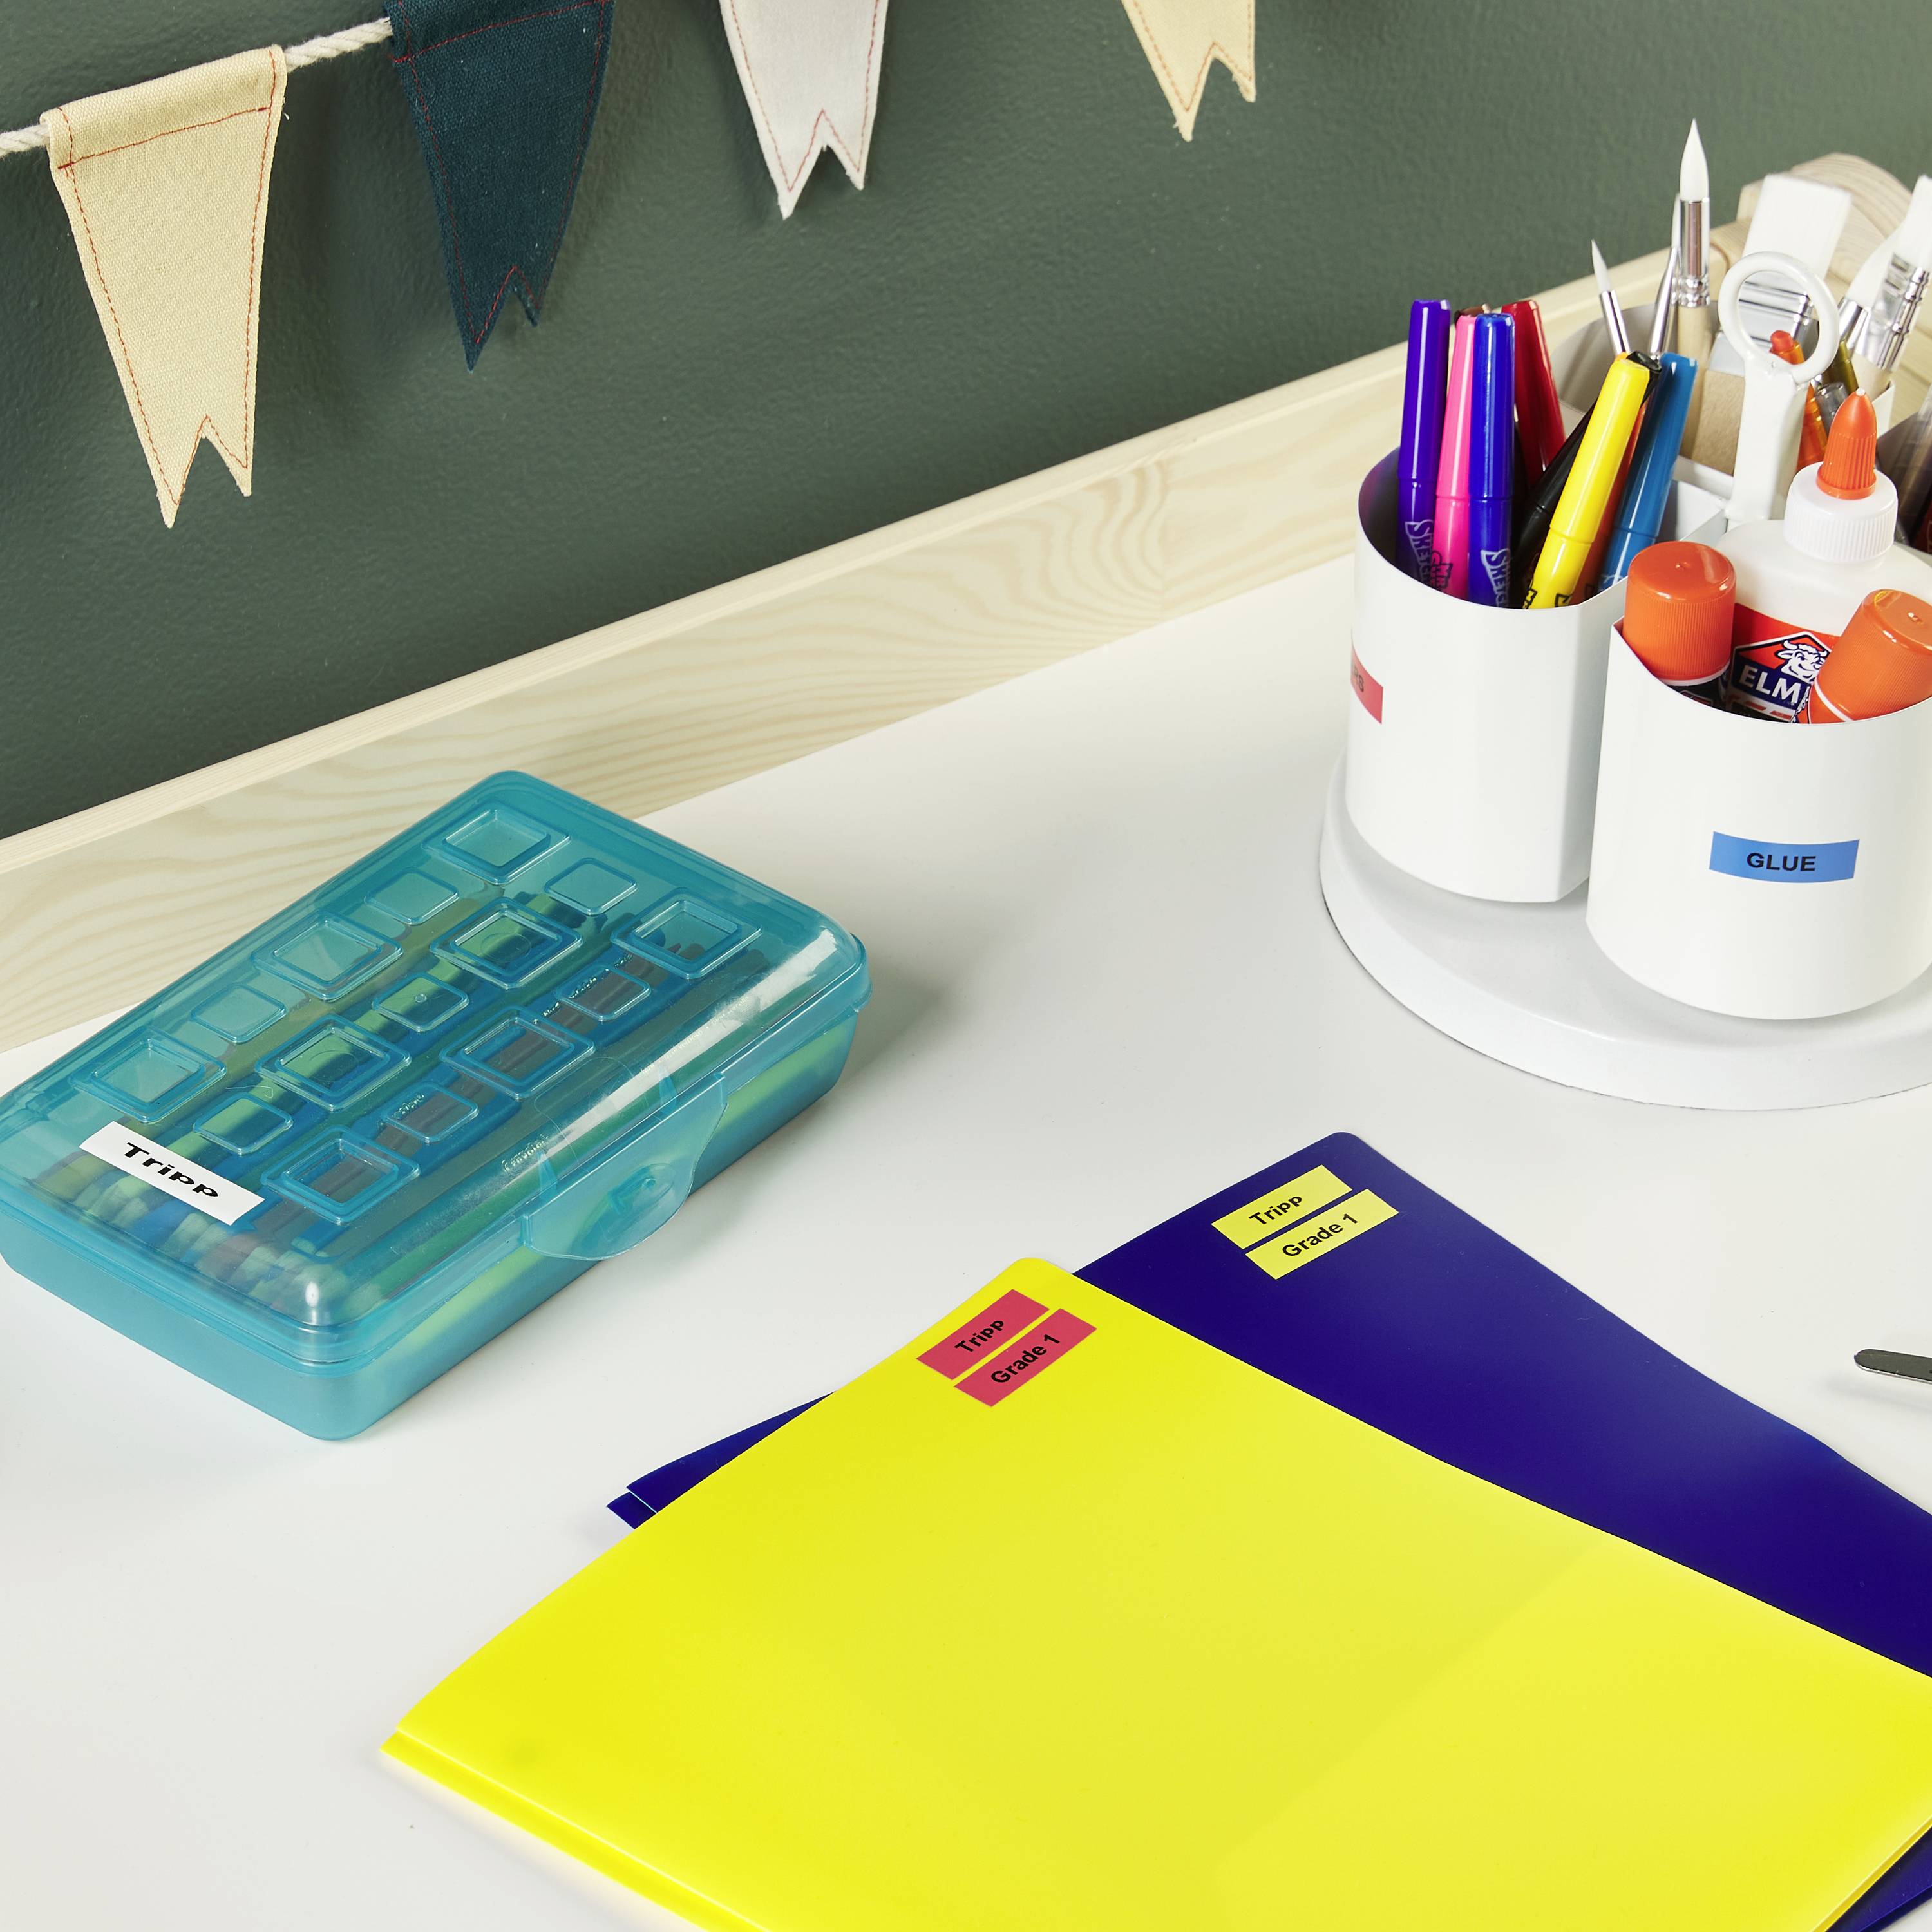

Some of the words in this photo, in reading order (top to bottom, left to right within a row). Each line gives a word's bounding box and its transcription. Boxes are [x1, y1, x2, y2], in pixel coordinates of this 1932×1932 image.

[1739, 665, 1809, 705] ELM
[1747, 853, 1816, 871] GLUE
[124, 1142, 218, 1197] Tripp
[1249, 1195, 1303, 1225] Tripp
[1282, 1224, 1343, 1256] Grade
[1343, 1213, 1358, 1224] 1
[954, 1320, 1004, 1352] Tripp
[991, 1345, 1047, 1383] Grade
[1043, 1334, 1060, 1344] 1
